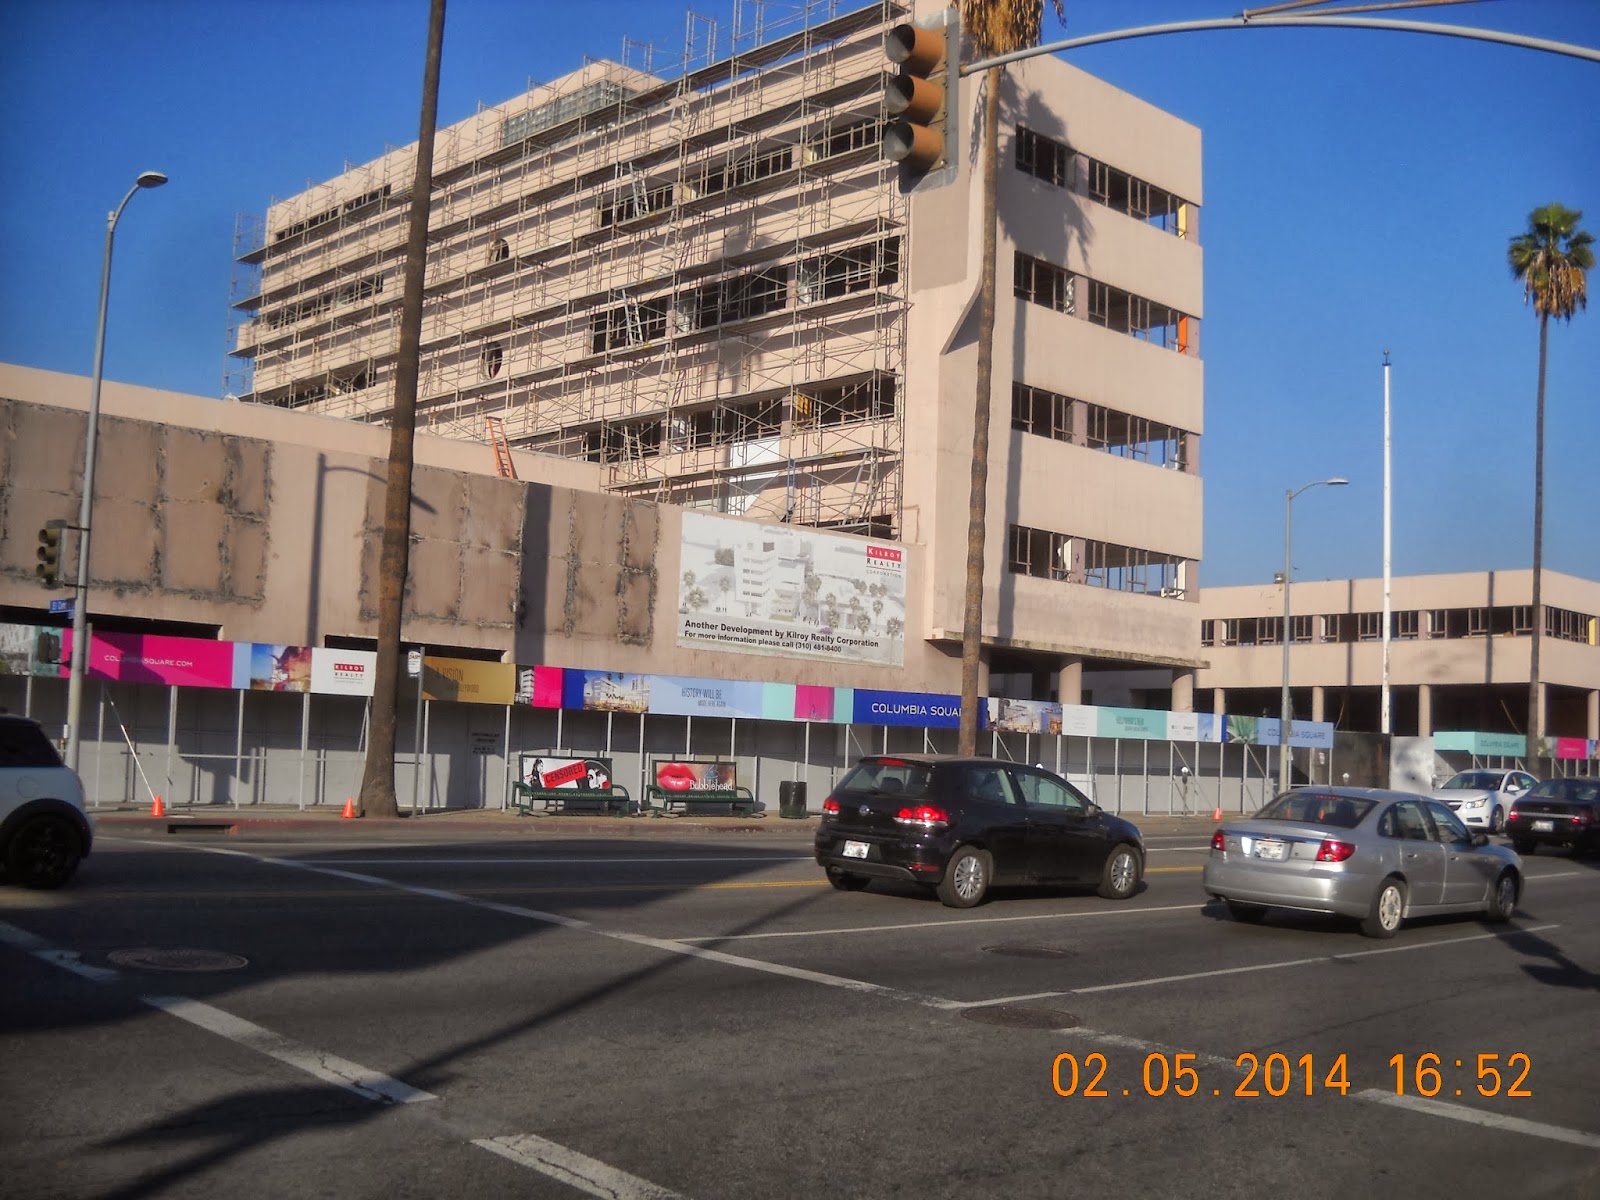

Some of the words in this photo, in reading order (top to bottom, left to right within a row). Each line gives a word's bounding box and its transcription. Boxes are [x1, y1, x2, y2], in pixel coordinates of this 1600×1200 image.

[868, 547, 900, 558] KILROY
[866, 558, 900, 568] REALTY
[684, 620, 718, 630] Another
[720, 623, 772, 636] Development
[775, 629, 784, 638] by
[786, 630, 808, 641] Kilroy
[811, 633, 834, 644] Realty
[836, 636, 878, 648] Corporation
[718, 634, 756, 644] information
[758, 638, 780, 647] please
[796, 642, 812, 650] (310)
[682, 688, 702, 698] HISTORY
[703, 688, 714, 699] WILL
[716, 690, 722, 700] BE
[872, 703, 927, 715] COLUMBIA
[930, 706, 962, 716] SQUA
[546, 763, 583, 783] CENSORED
